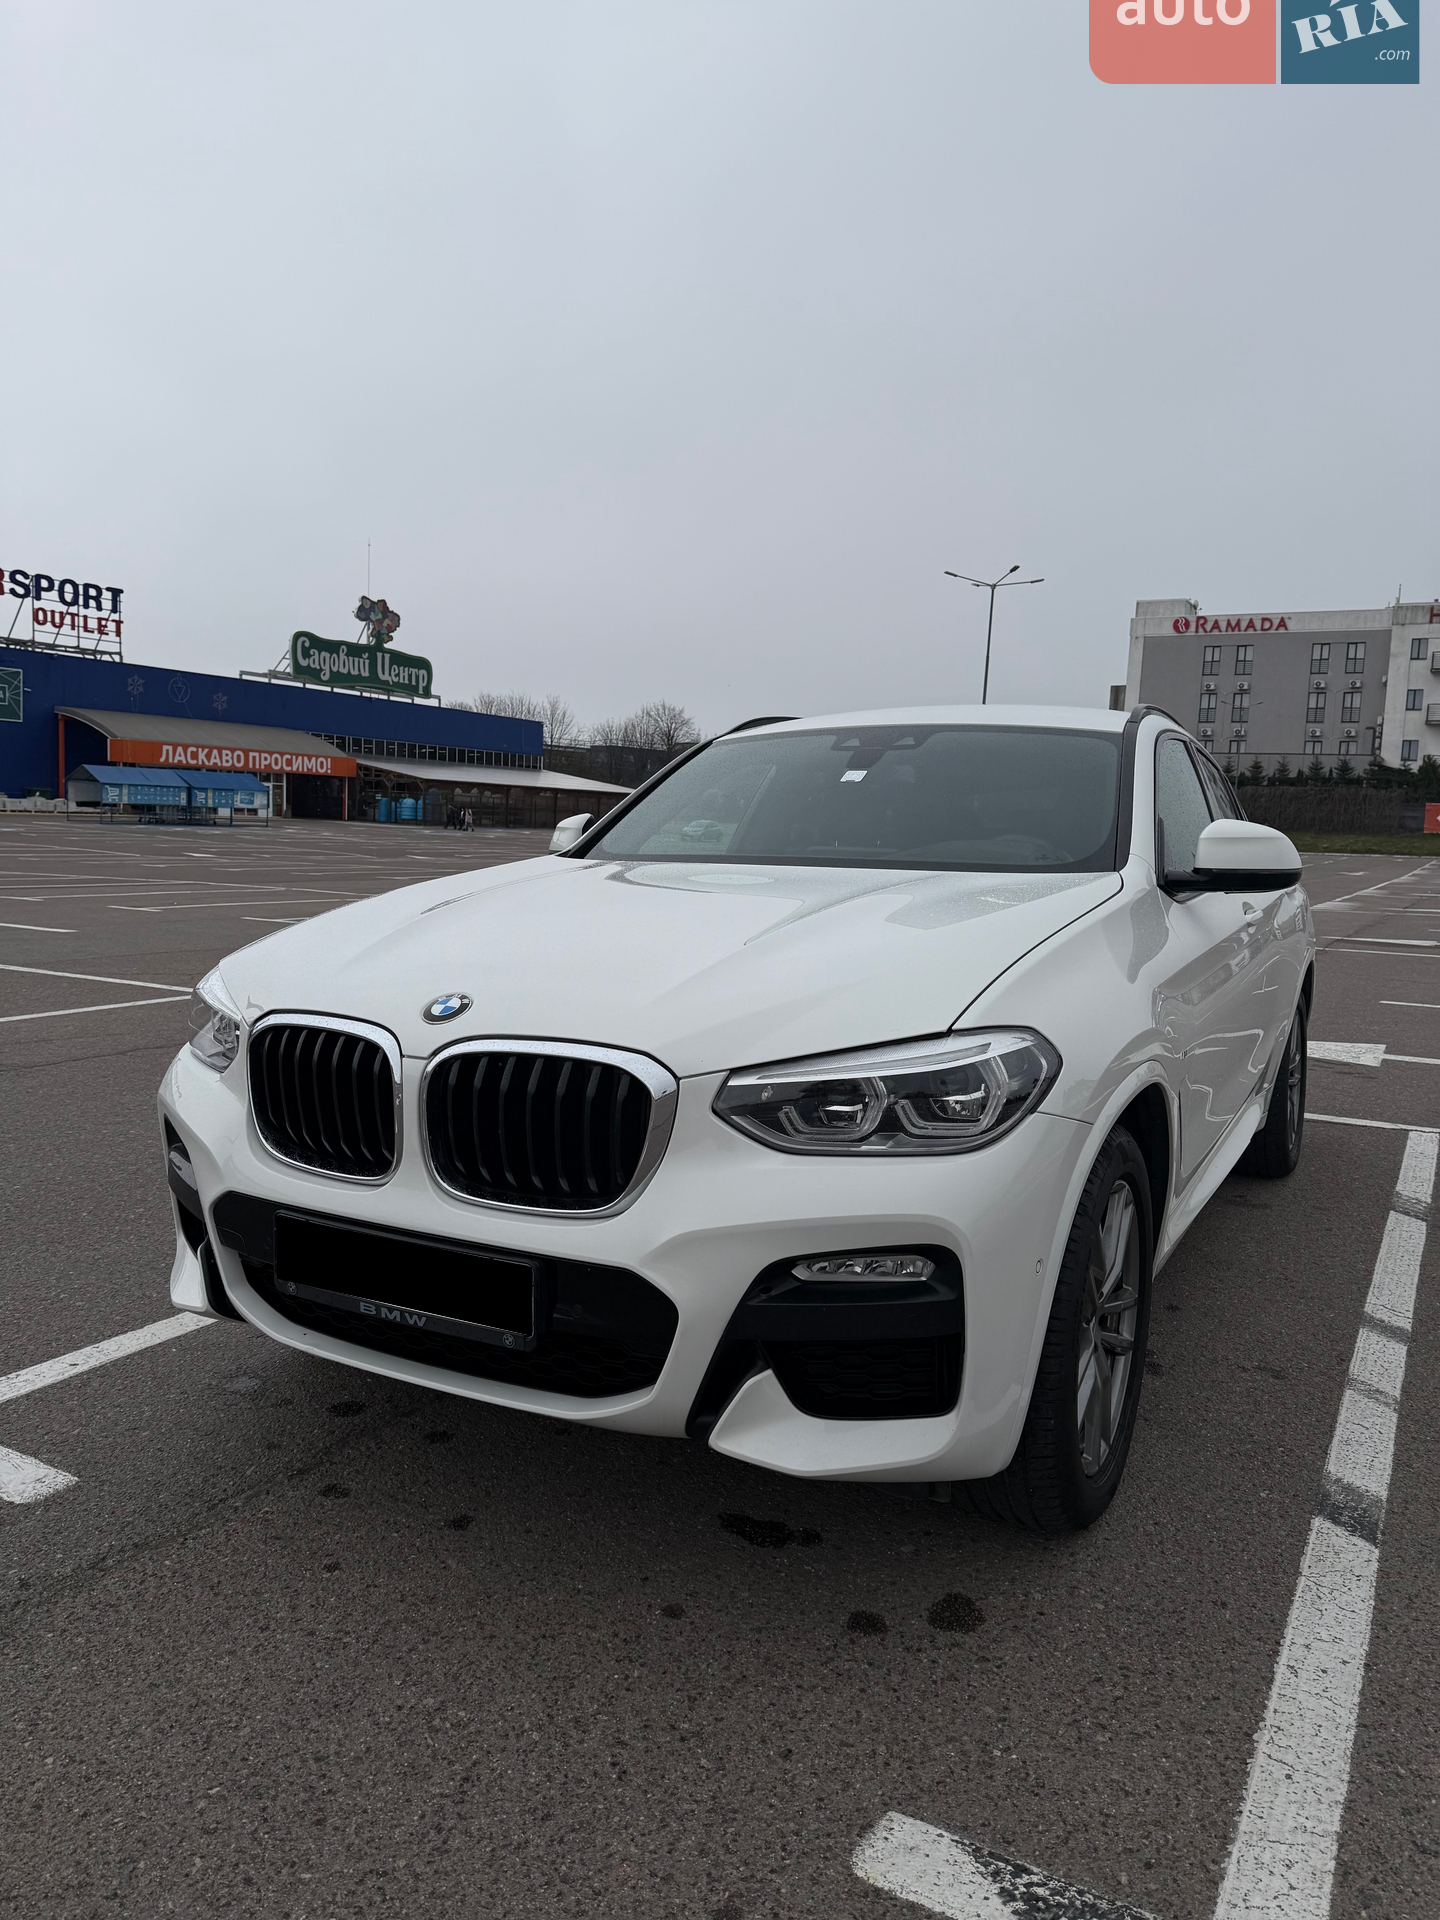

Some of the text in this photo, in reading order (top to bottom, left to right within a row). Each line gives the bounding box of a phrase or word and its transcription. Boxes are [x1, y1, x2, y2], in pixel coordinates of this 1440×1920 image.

[0, 567, 124, 614] SPORT
[33, 607, 124, 638] OUTLET
[1195, 615, 1289, 634] RAMADA
[296, 636, 428, 694] Садовий Центр
[159, 745, 331, 774] ЛАСКАВО ПРОСИМО!
[359, 1301, 427, 1327] BMW
